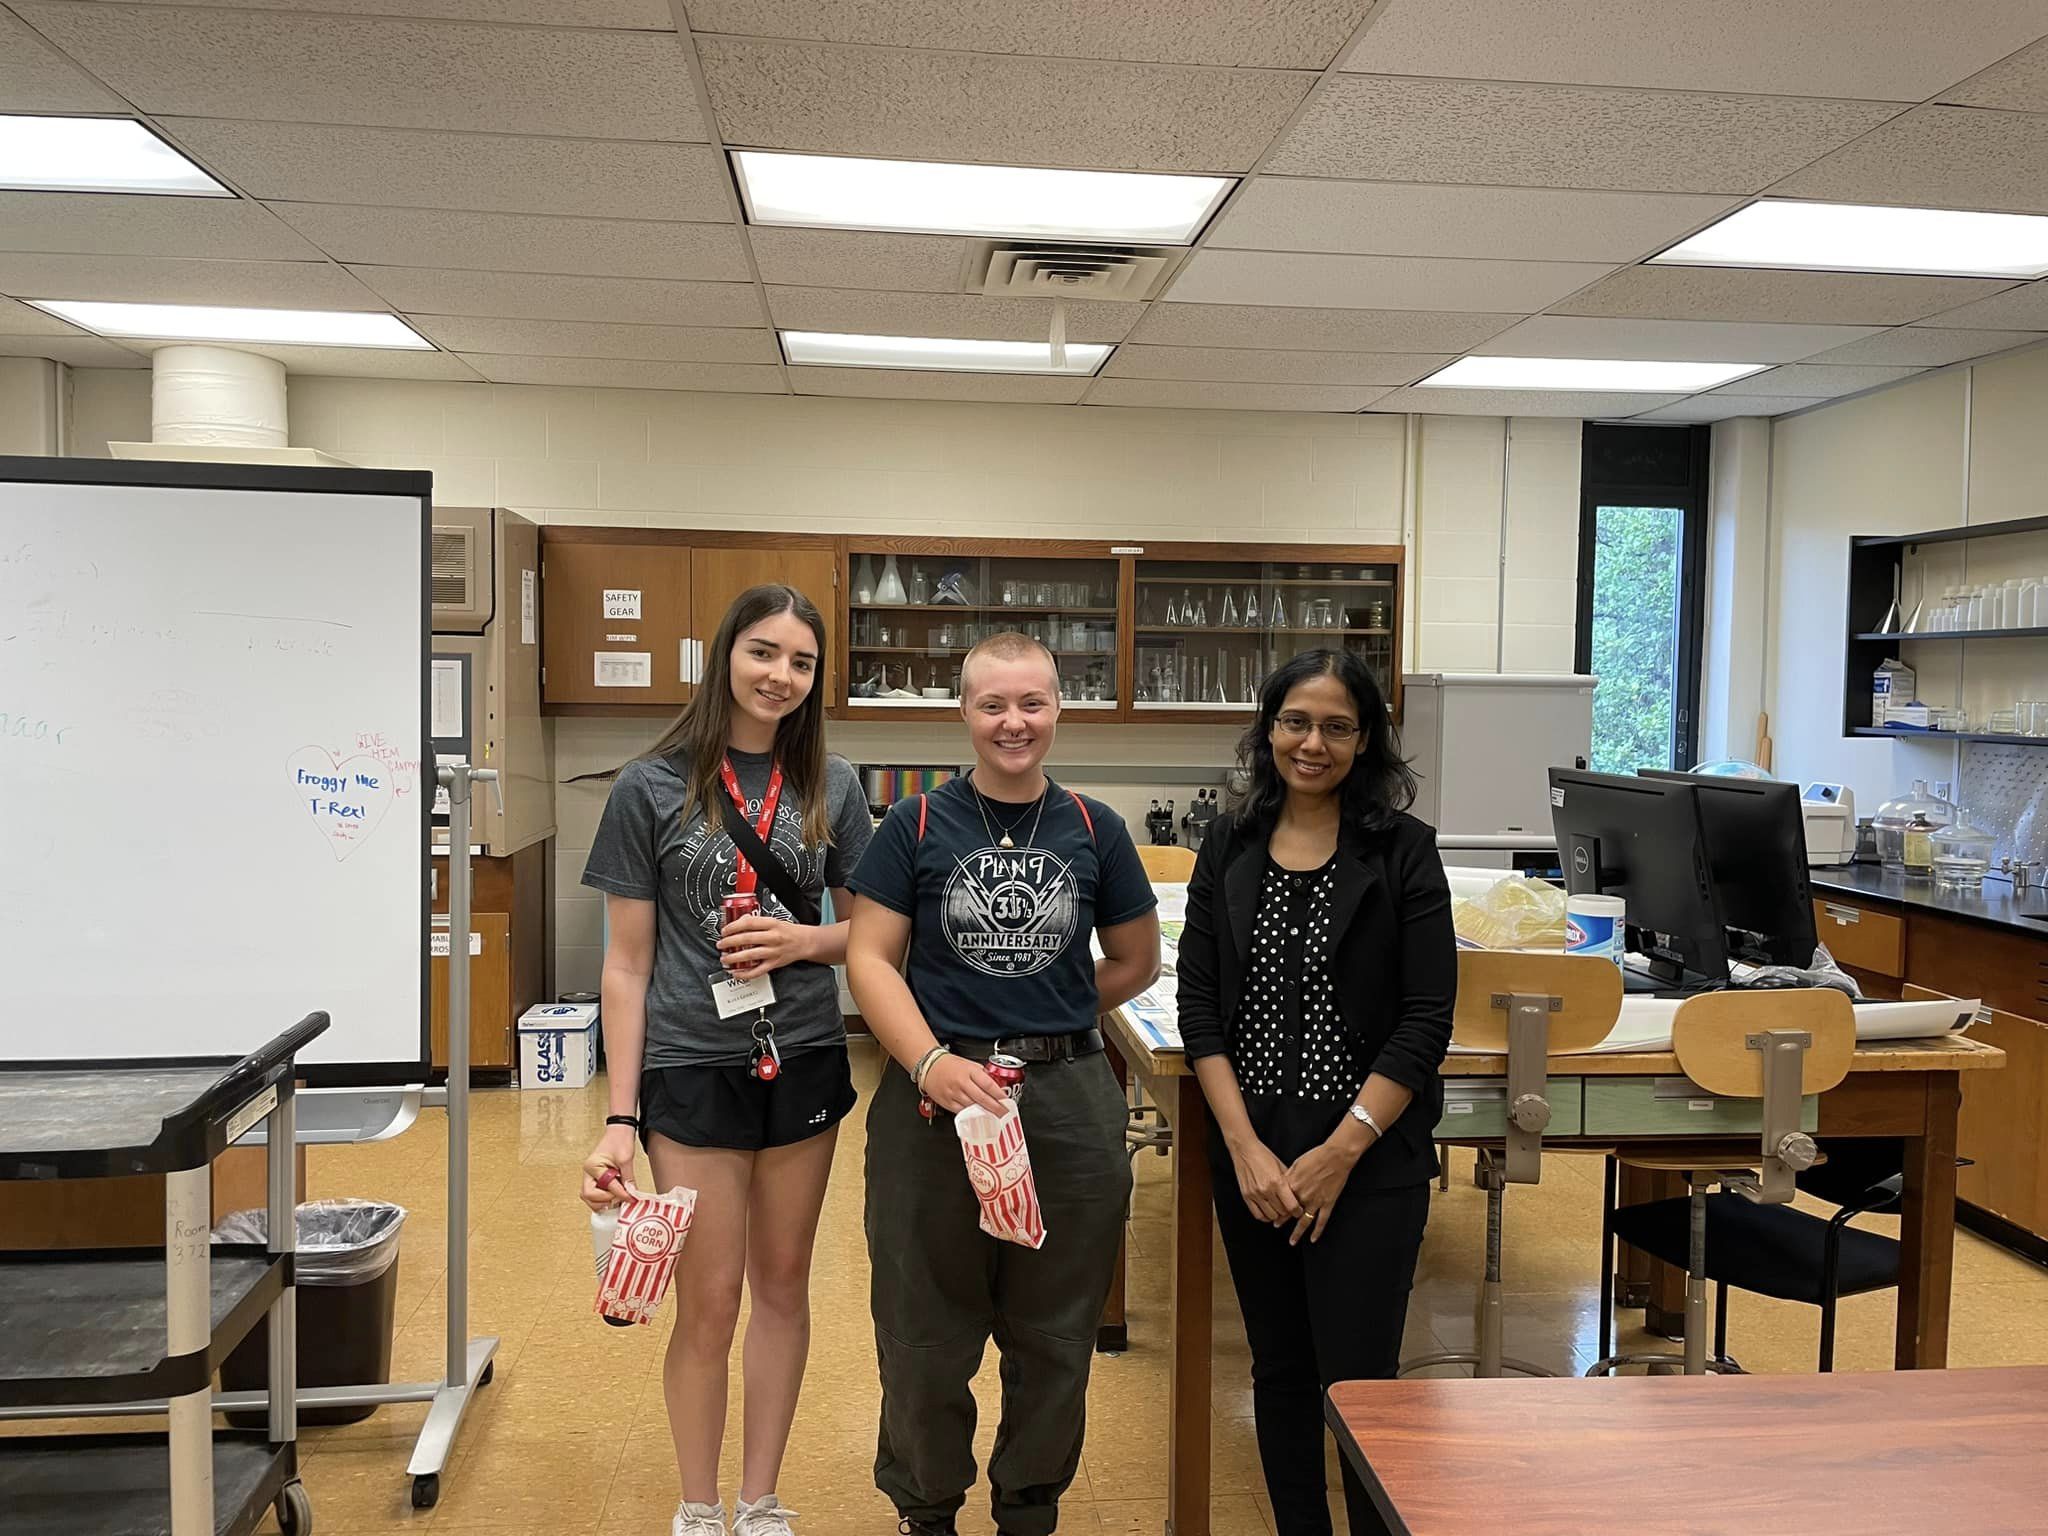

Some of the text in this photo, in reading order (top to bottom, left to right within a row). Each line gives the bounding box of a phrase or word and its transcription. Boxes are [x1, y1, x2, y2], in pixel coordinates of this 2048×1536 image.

[605, 593, 638, 602] SAFETY
[609, 607, 634, 616] GEAR
[297, 768, 380, 793] Froggy the
[310, 798, 366, 821] T-Rex!
[978, 854, 1046, 884] PLAN 9
[960, 934, 1060, 949] ANNIVERSARY
[986, 951, 1031, 962] Since 1981
[175, 1220, 207, 1239] Room
[642, 1225, 663, 1237] POP
[636, 1233, 663, 1248] CORN
